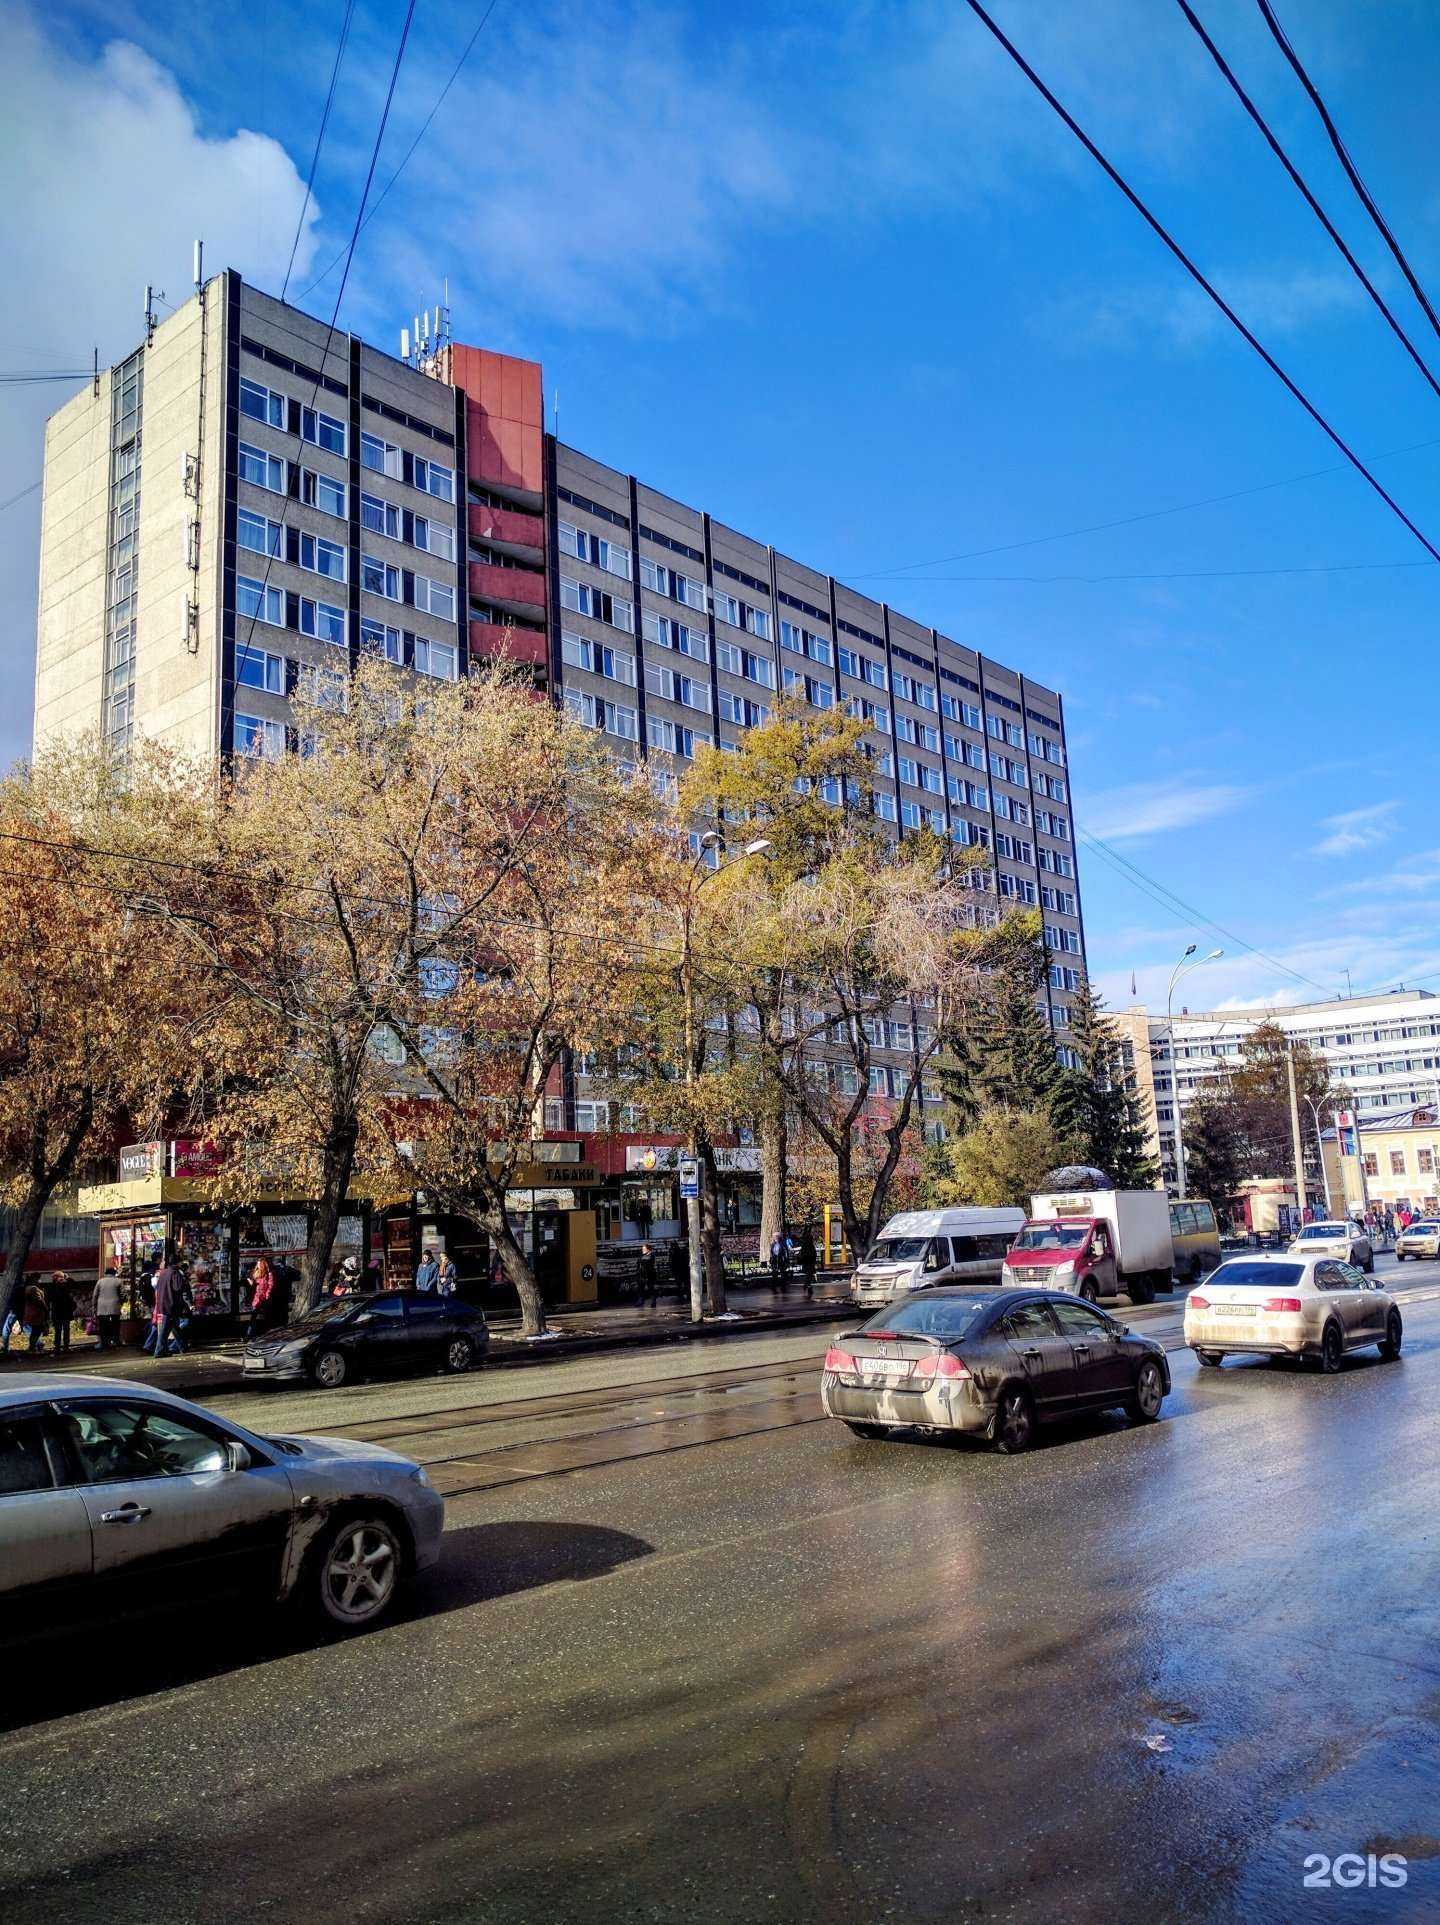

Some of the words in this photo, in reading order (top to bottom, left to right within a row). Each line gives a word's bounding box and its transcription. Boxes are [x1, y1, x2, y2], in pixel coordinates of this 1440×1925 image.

[122, 1154, 146, 1169] VOGUE
[546, 1168, 594, 1181] ТАБАКИ
[583, 1267, 593, 1278] 24
